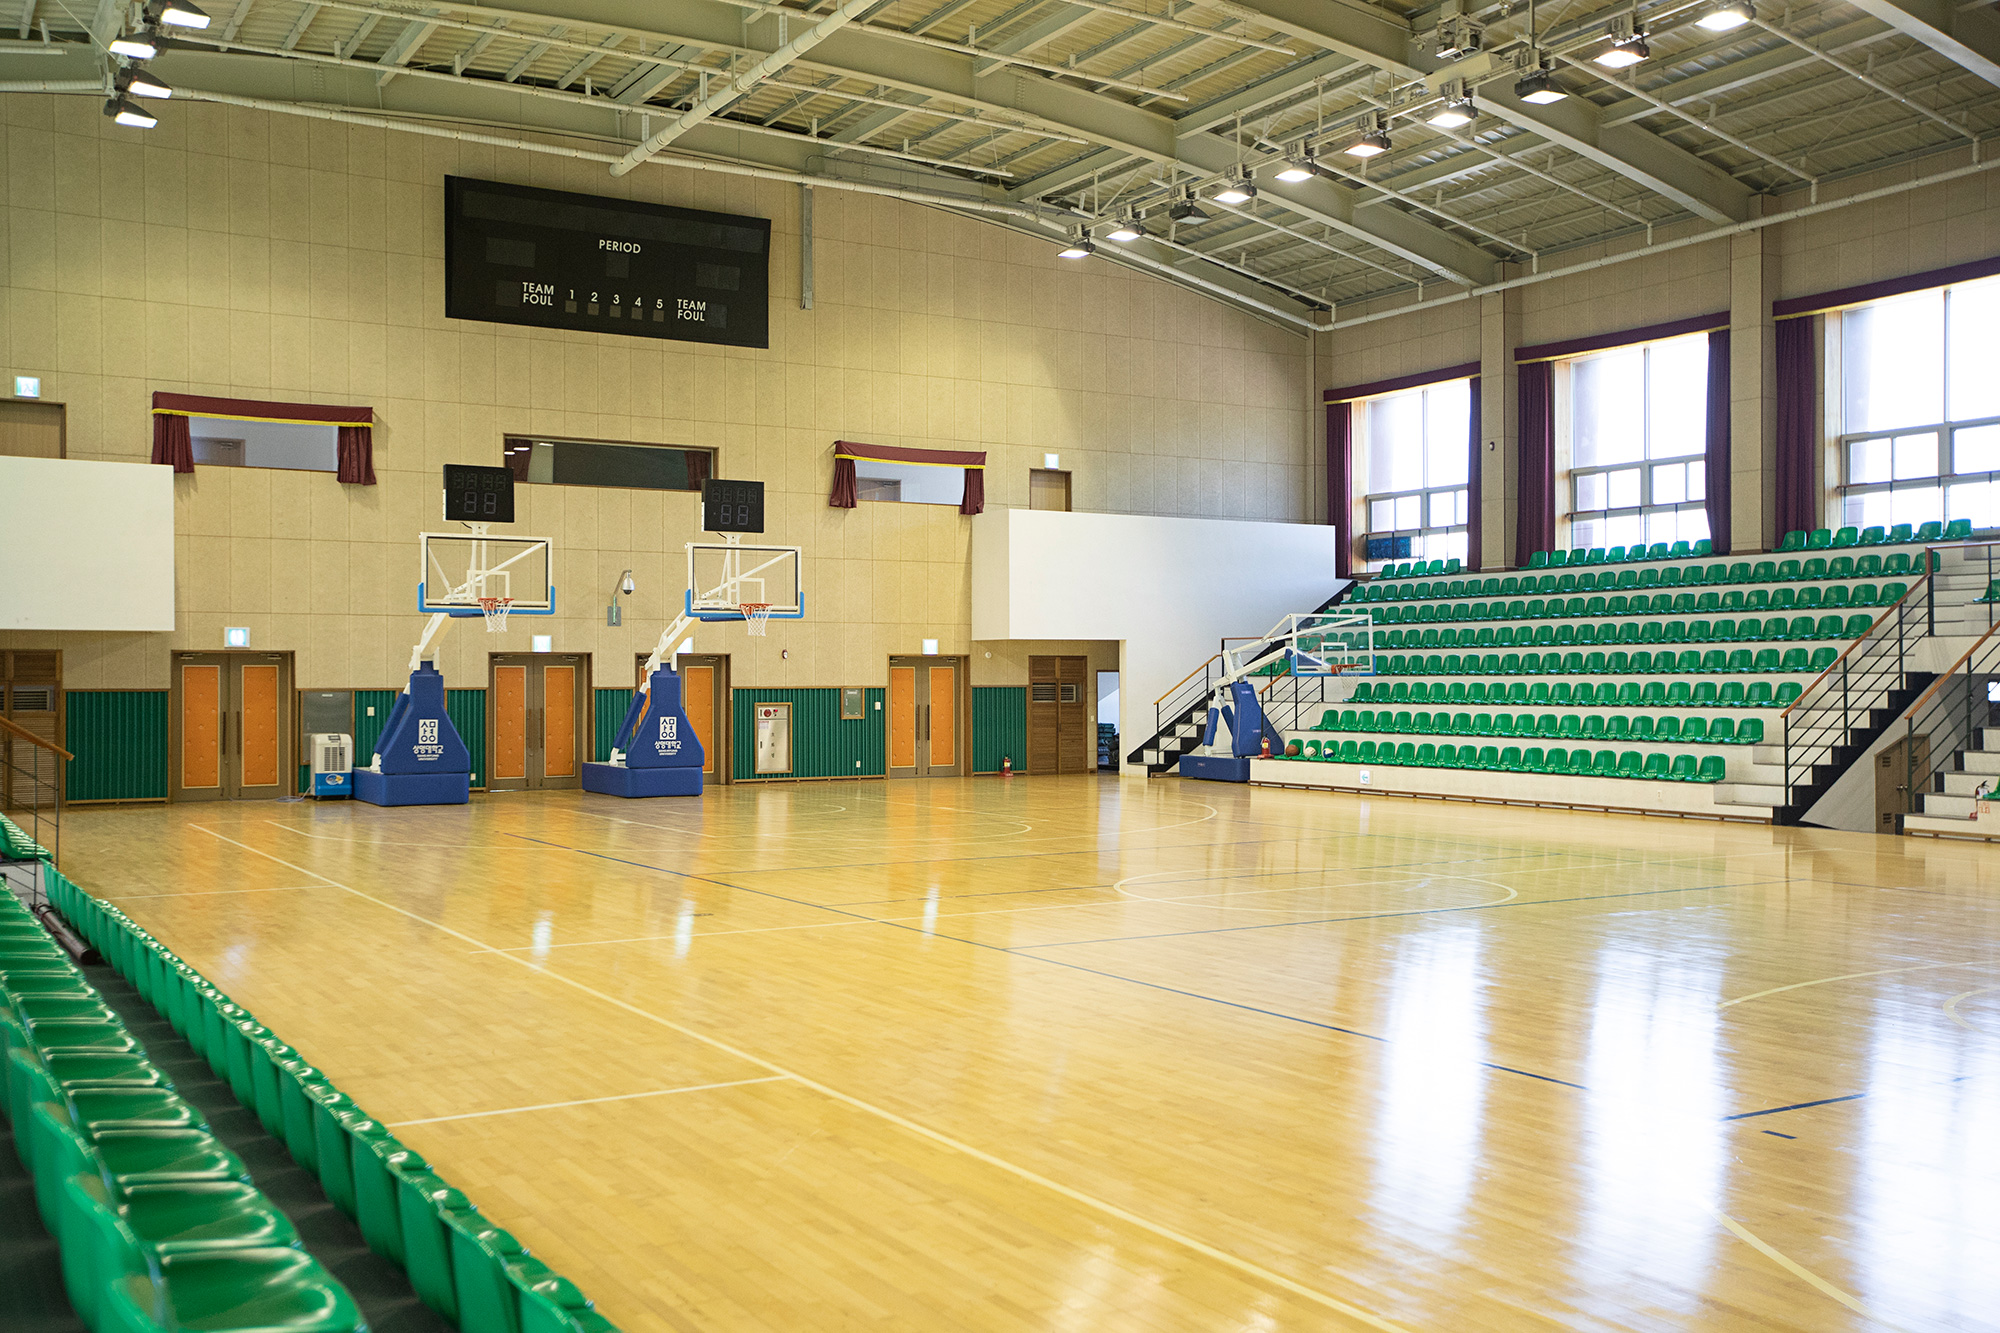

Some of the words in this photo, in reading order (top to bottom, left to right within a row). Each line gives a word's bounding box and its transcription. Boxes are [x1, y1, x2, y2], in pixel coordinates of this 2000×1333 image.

[599, 239, 641, 254] PERIOD
[522, 282, 554, 295] TEAM
[523, 293, 553, 306] FOUL
[569, 289, 574, 299] 1
[591, 292, 598, 302] 2
[613, 294, 620, 304] 3
[634, 297, 641, 307] 4
[656, 299, 663, 309] 5
[677, 299, 706, 311] TEAM
[677, 310, 705, 322] FOUL
